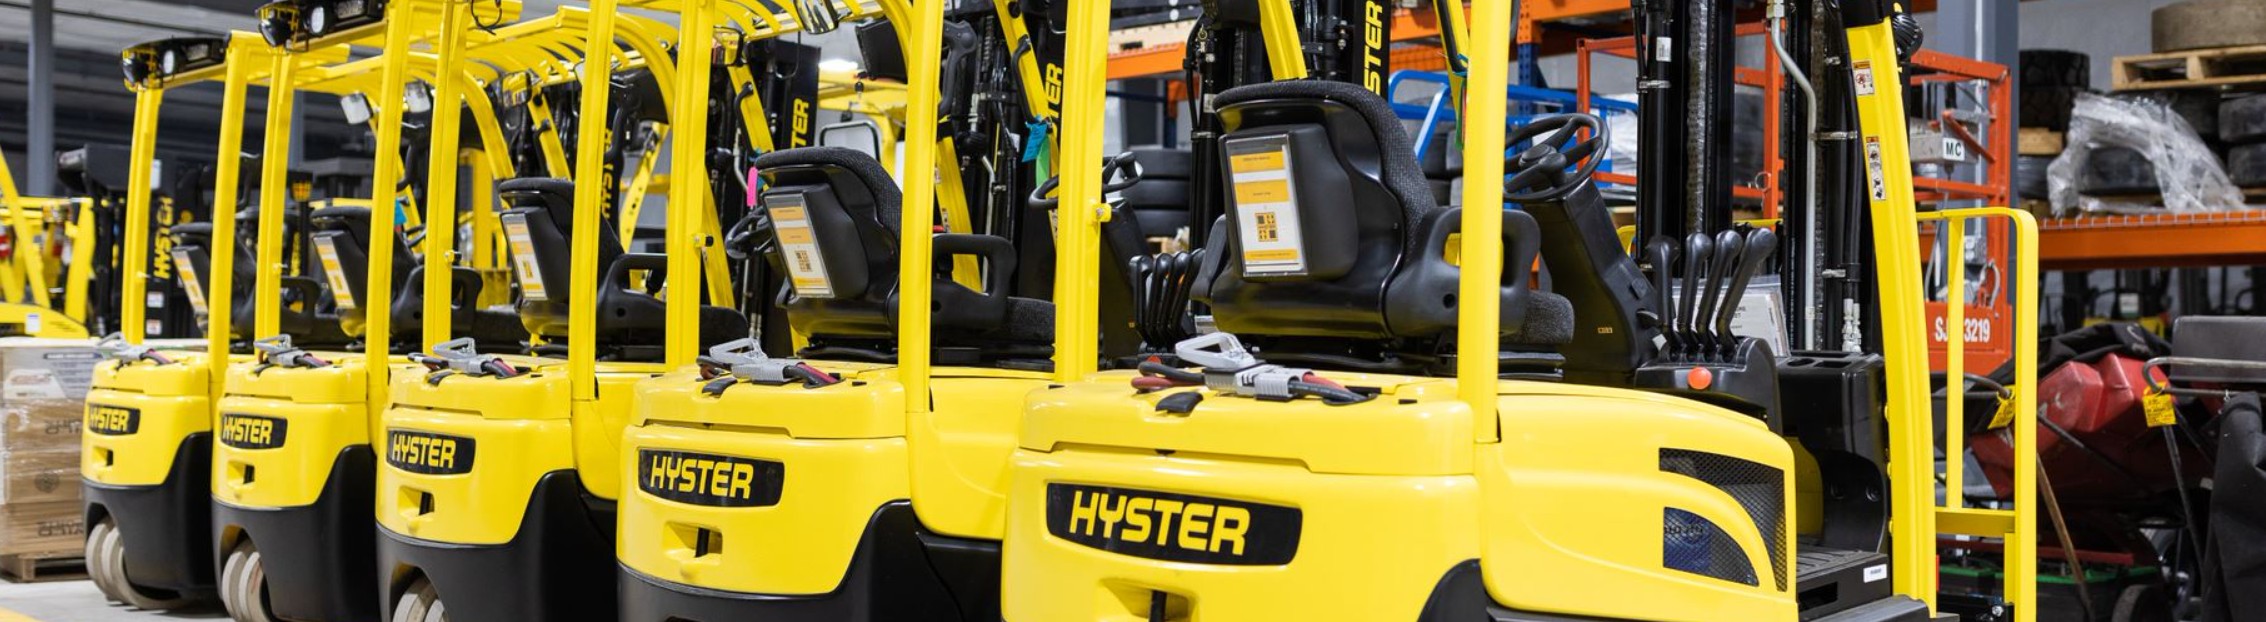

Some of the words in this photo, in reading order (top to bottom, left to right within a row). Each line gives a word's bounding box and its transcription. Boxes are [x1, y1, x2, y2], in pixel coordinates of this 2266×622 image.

[1364, 0, 1382, 97] STER
[1045, 63, 1063, 121] TER
[790, 98, 810, 149] TER
[1946, 142, 1962, 156] MC
[1935, 316, 1949, 342] SJ
[1964, 318, 1990, 343] 3219
[90, 407, 129, 431] HYSTER
[222, 416, 273, 445] HYSTER
[392, 434, 456, 469] HYSTER
[650, 455, 754, 499] HYSTER
[1069, 490, 1250, 555] HYSTER
